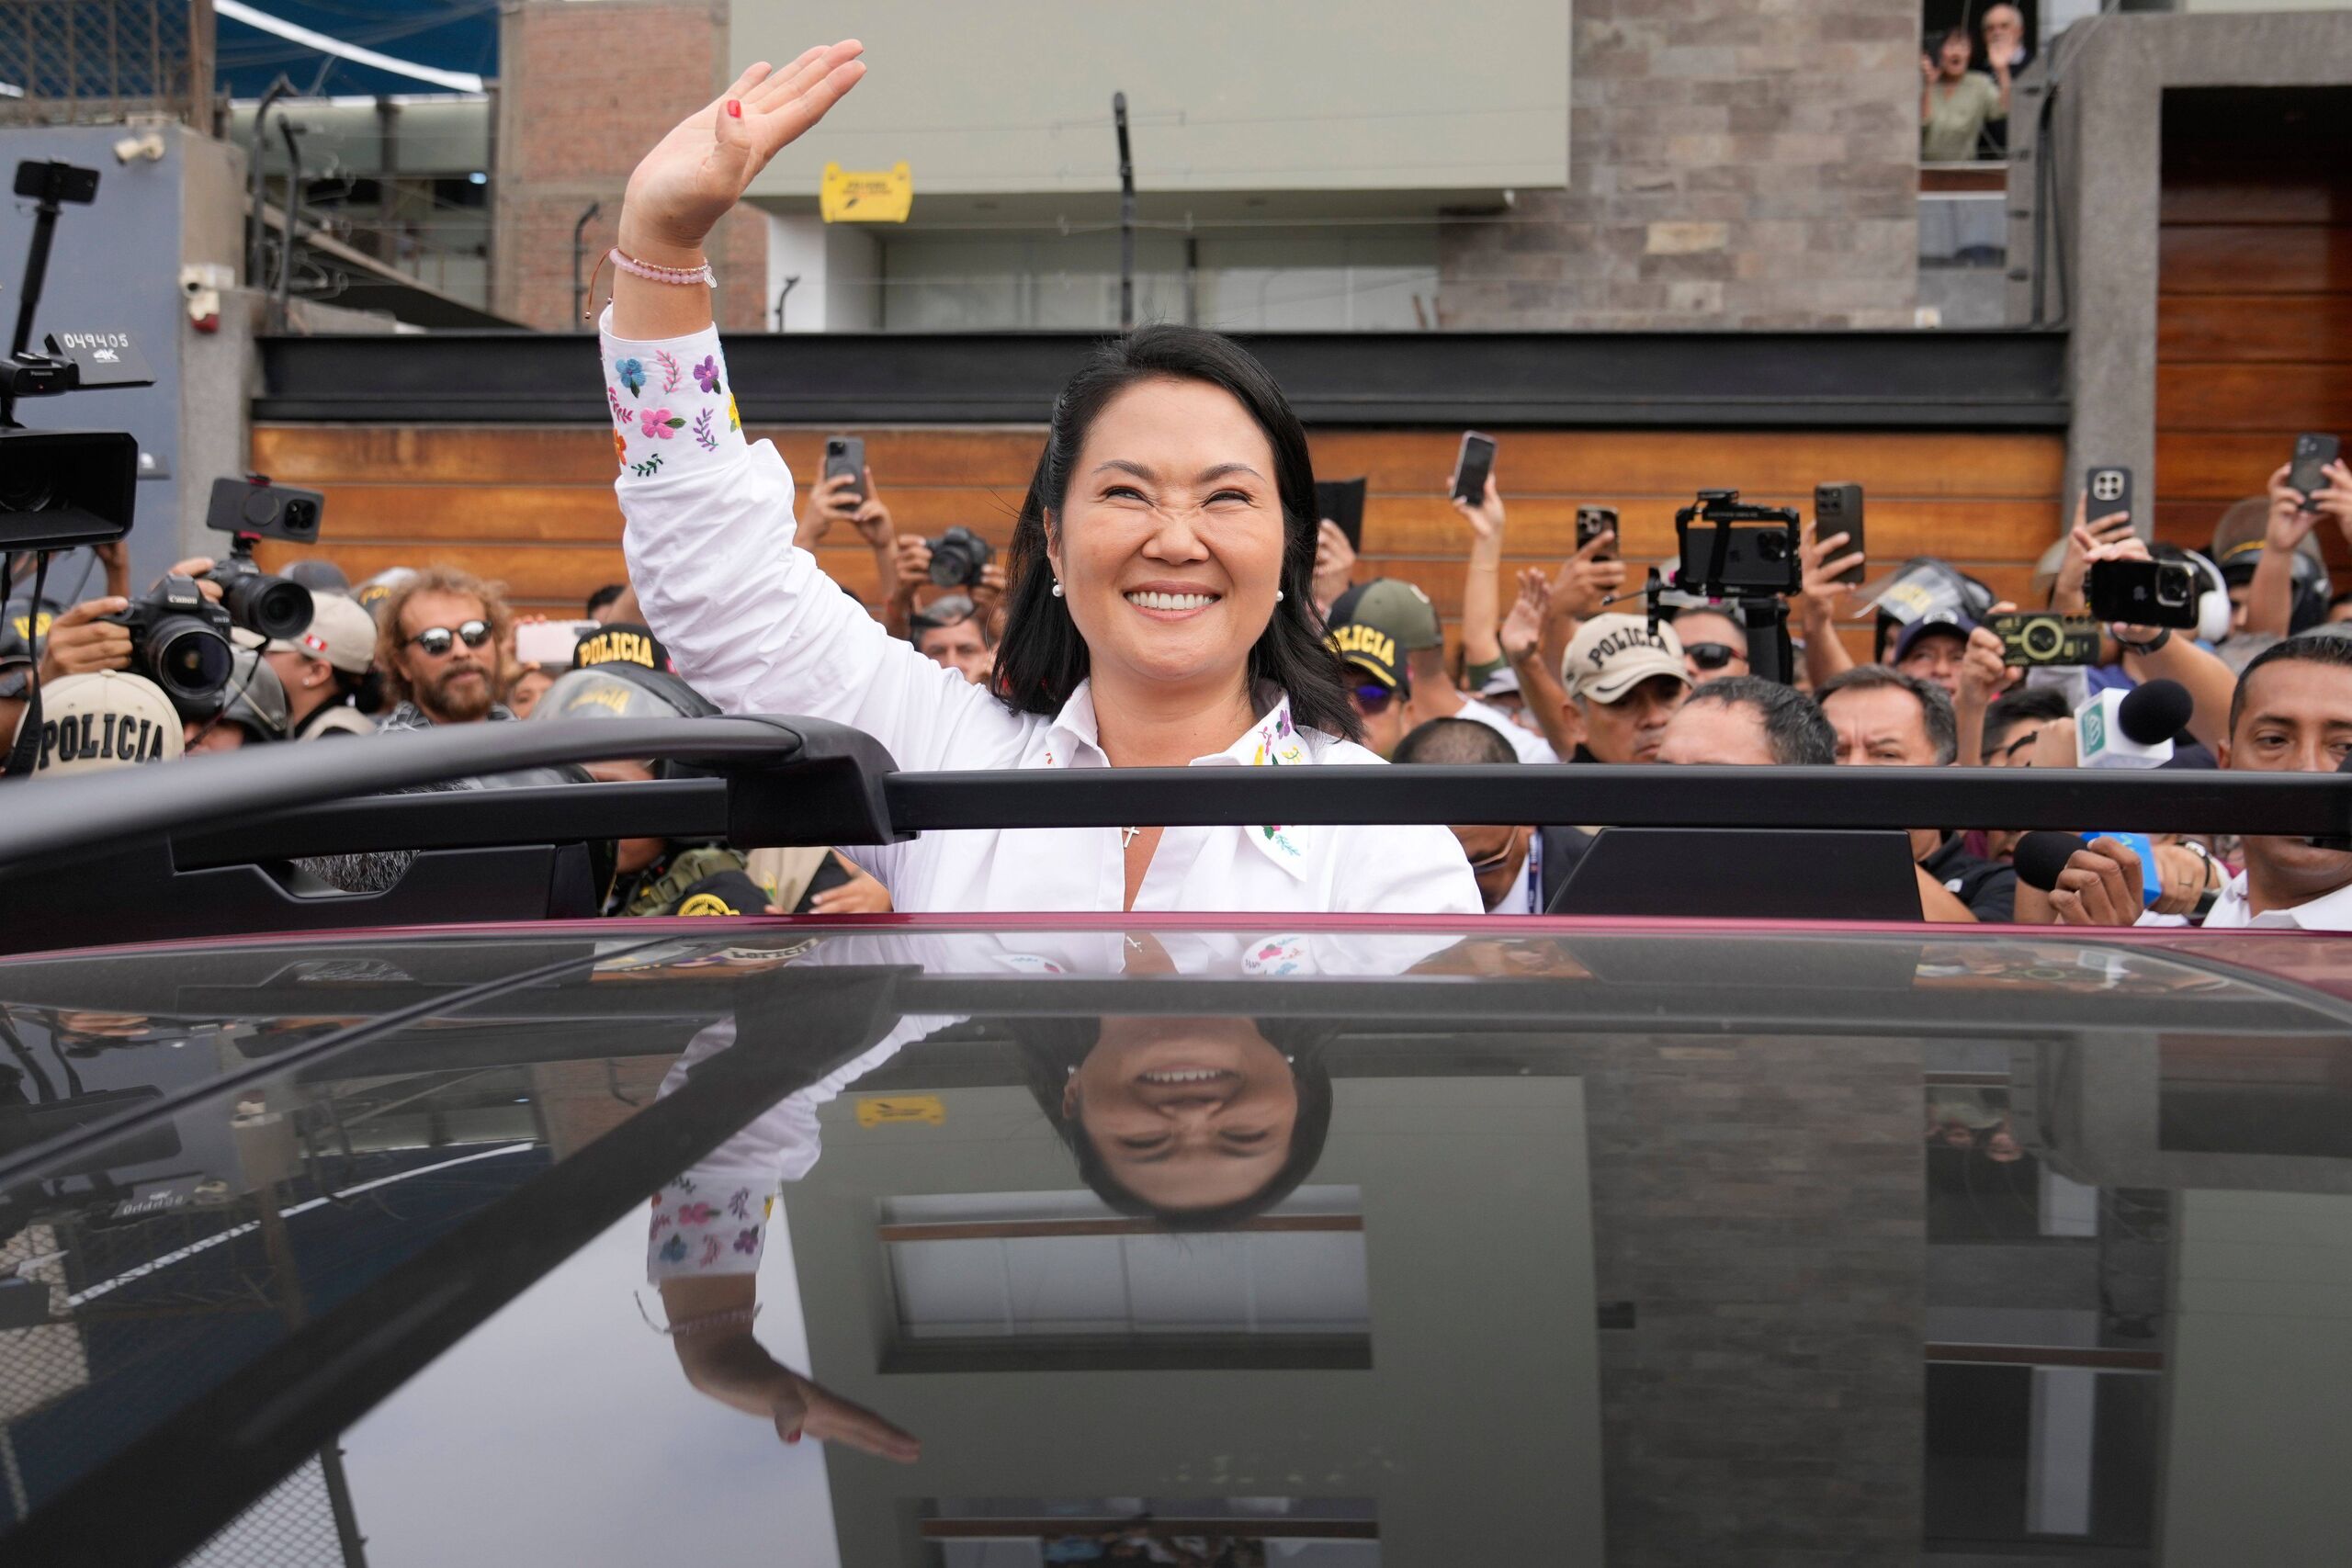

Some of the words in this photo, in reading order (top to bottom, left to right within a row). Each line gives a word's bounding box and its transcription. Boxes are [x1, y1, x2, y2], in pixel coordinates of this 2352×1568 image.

[62, 332, 130, 349] 049405
[167, 593, 198, 605] Canon
[578, 631, 655, 669] POLICIA
[38, 712, 164, 771] POLICIA
